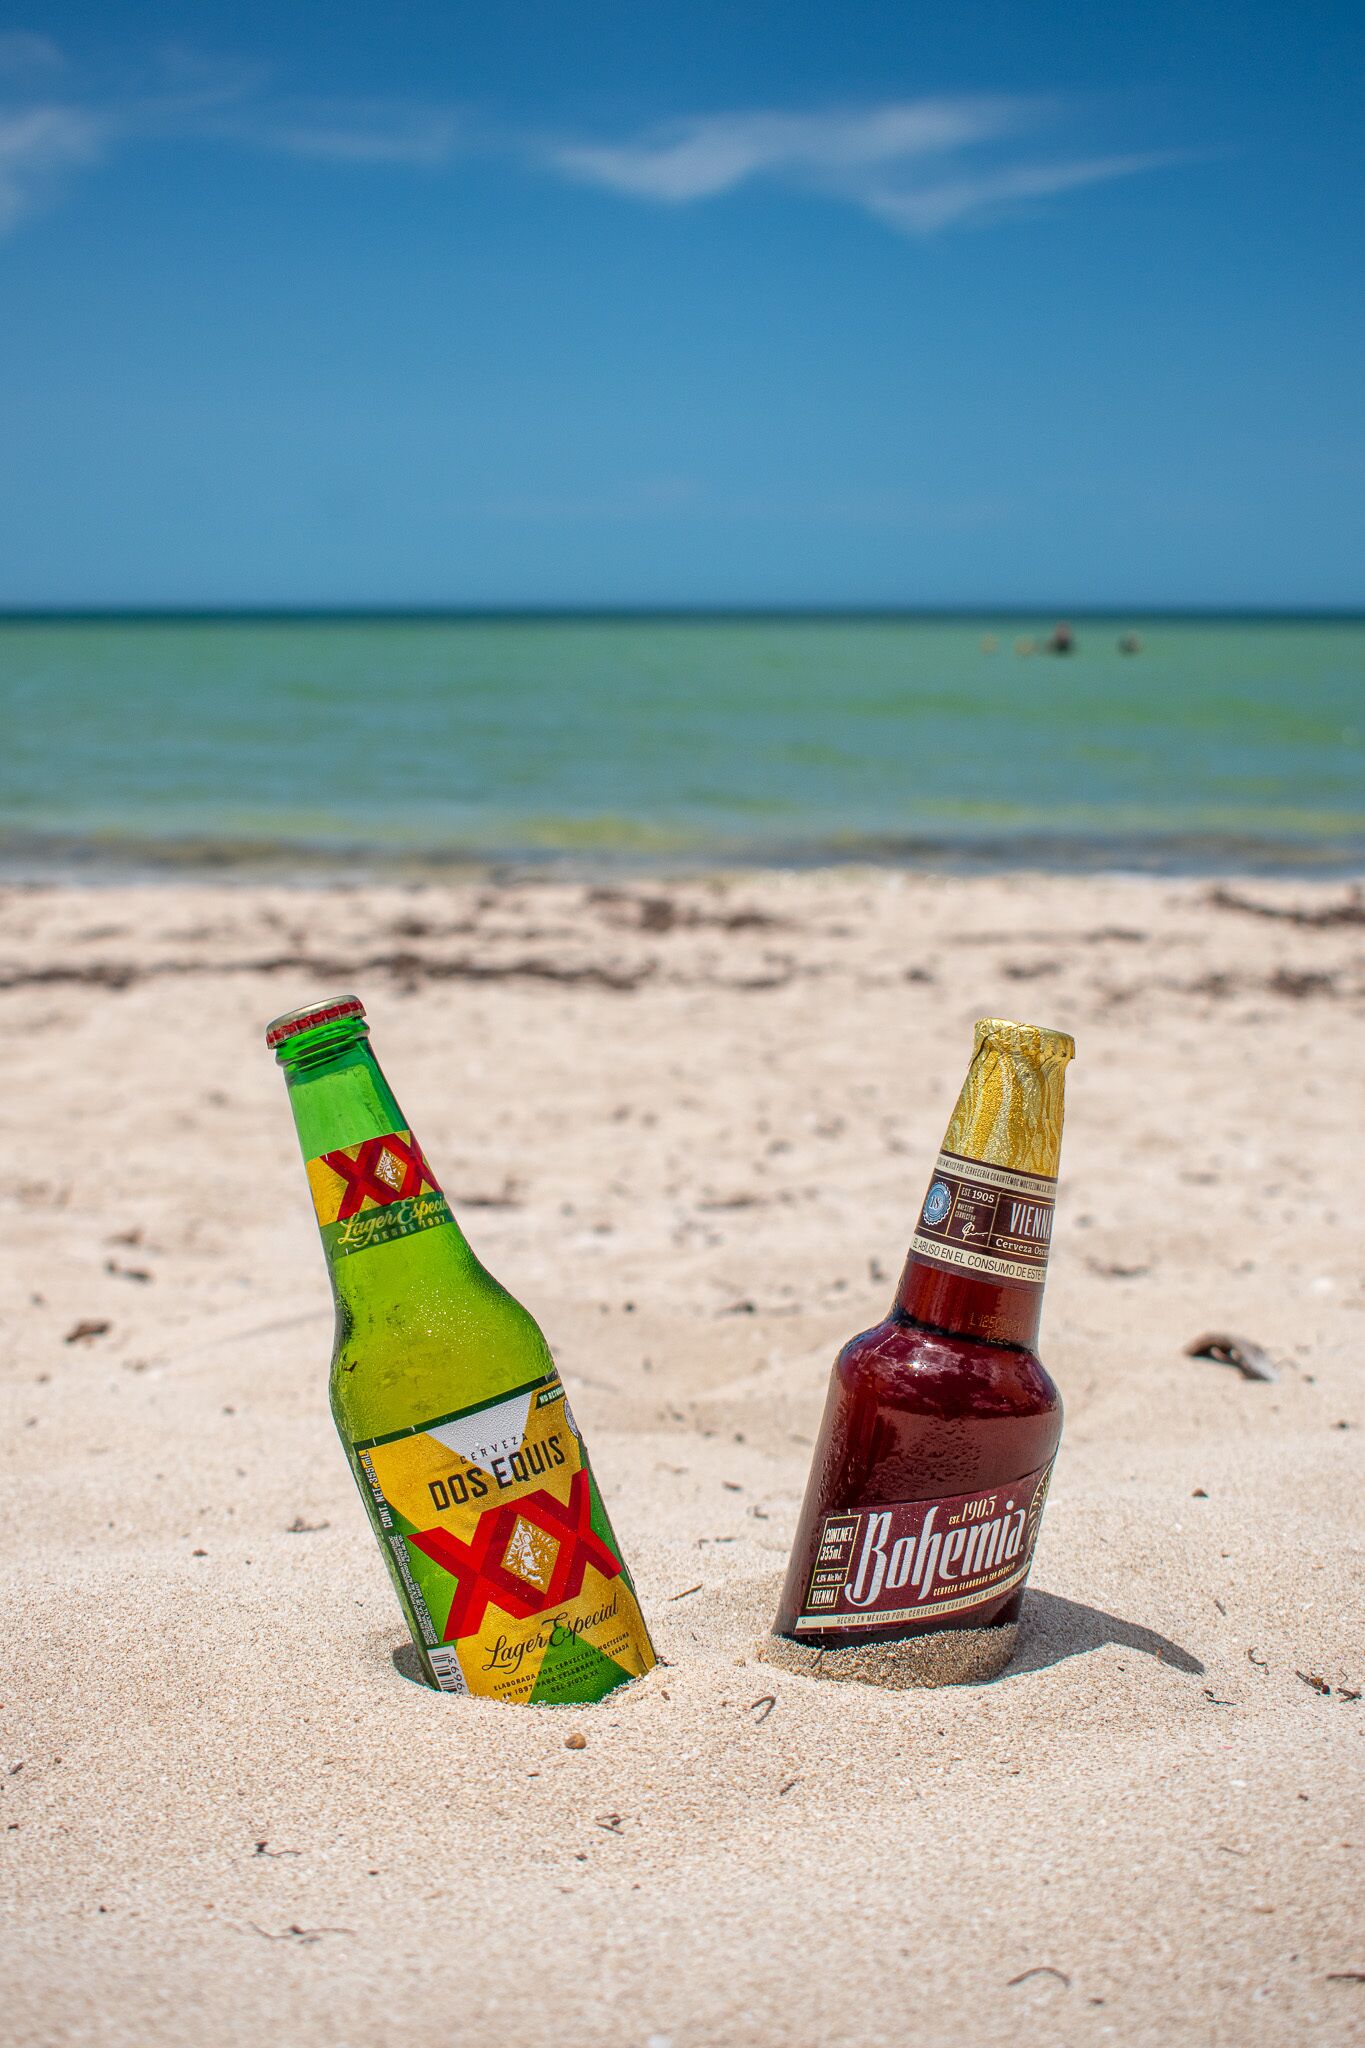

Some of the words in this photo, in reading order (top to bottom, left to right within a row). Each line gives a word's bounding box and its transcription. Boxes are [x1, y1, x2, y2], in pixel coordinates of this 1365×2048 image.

[972, 1190, 995, 1204] 1905
[338, 1208, 397, 1248] Lager
[996, 1238, 1033, 1254] Cerveza
[918, 1239, 941, 1256] ABUSO
[941, 1246, 953, 1260] EN
[954, 1251, 965, 1264] EL
[967, 1255, 1015, 1275] CONSUMO
[1016, 1266, 1026, 1278] DE
[1027, 1268, 1041, 1281] ESTE
[460, 1433, 528, 1464] CERVEZA
[365, 1465, 377, 1483] 355
[428, 1467, 488, 1511] DOS
[491, 1435, 565, 1490] EQUIS
[371, 1484, 385, 1503] NET.
[377, 1503, 394, 1528] CONT.
[949, 1515, 960, 1525] EST.
[962, 1495, 998, 1522] 1905
[844, 1500, 1026, 1607] Bohemia
[812, 1589, 835, 1605] VIENNA
[933, 1585, 958, 1597] CERVEZA
[959, 1574, 988, 1591] ELABORADA
[836, 1615, 856, 1625] HECHO
[856, 1614, 865, 1623] EN
[481, 1635, 548, 1675] Lager
[541, 1593, 619, 1646] Especial
[494, 1674, 536, 1692] ELABORADA
[538, 1666, 553, 1677] POR
[597, 1632, 630, 1651] MOCTEZUMA
[502, 1690, 512, 1699] EN
[514, 1683, 533, 1695] 1897
[536, 1674, 556, 1689] PARA
[557, 1662, 594, 1681] CELEBRAR
[597, 1655, 605, 1664] LA
[605, 1643, 630, 1659] LLEGADA
[551, 1683, 565, 1693] DEL
[567, 1674, 588, 1689] SIGLO
[590, 1669, 600, 1677] XX
